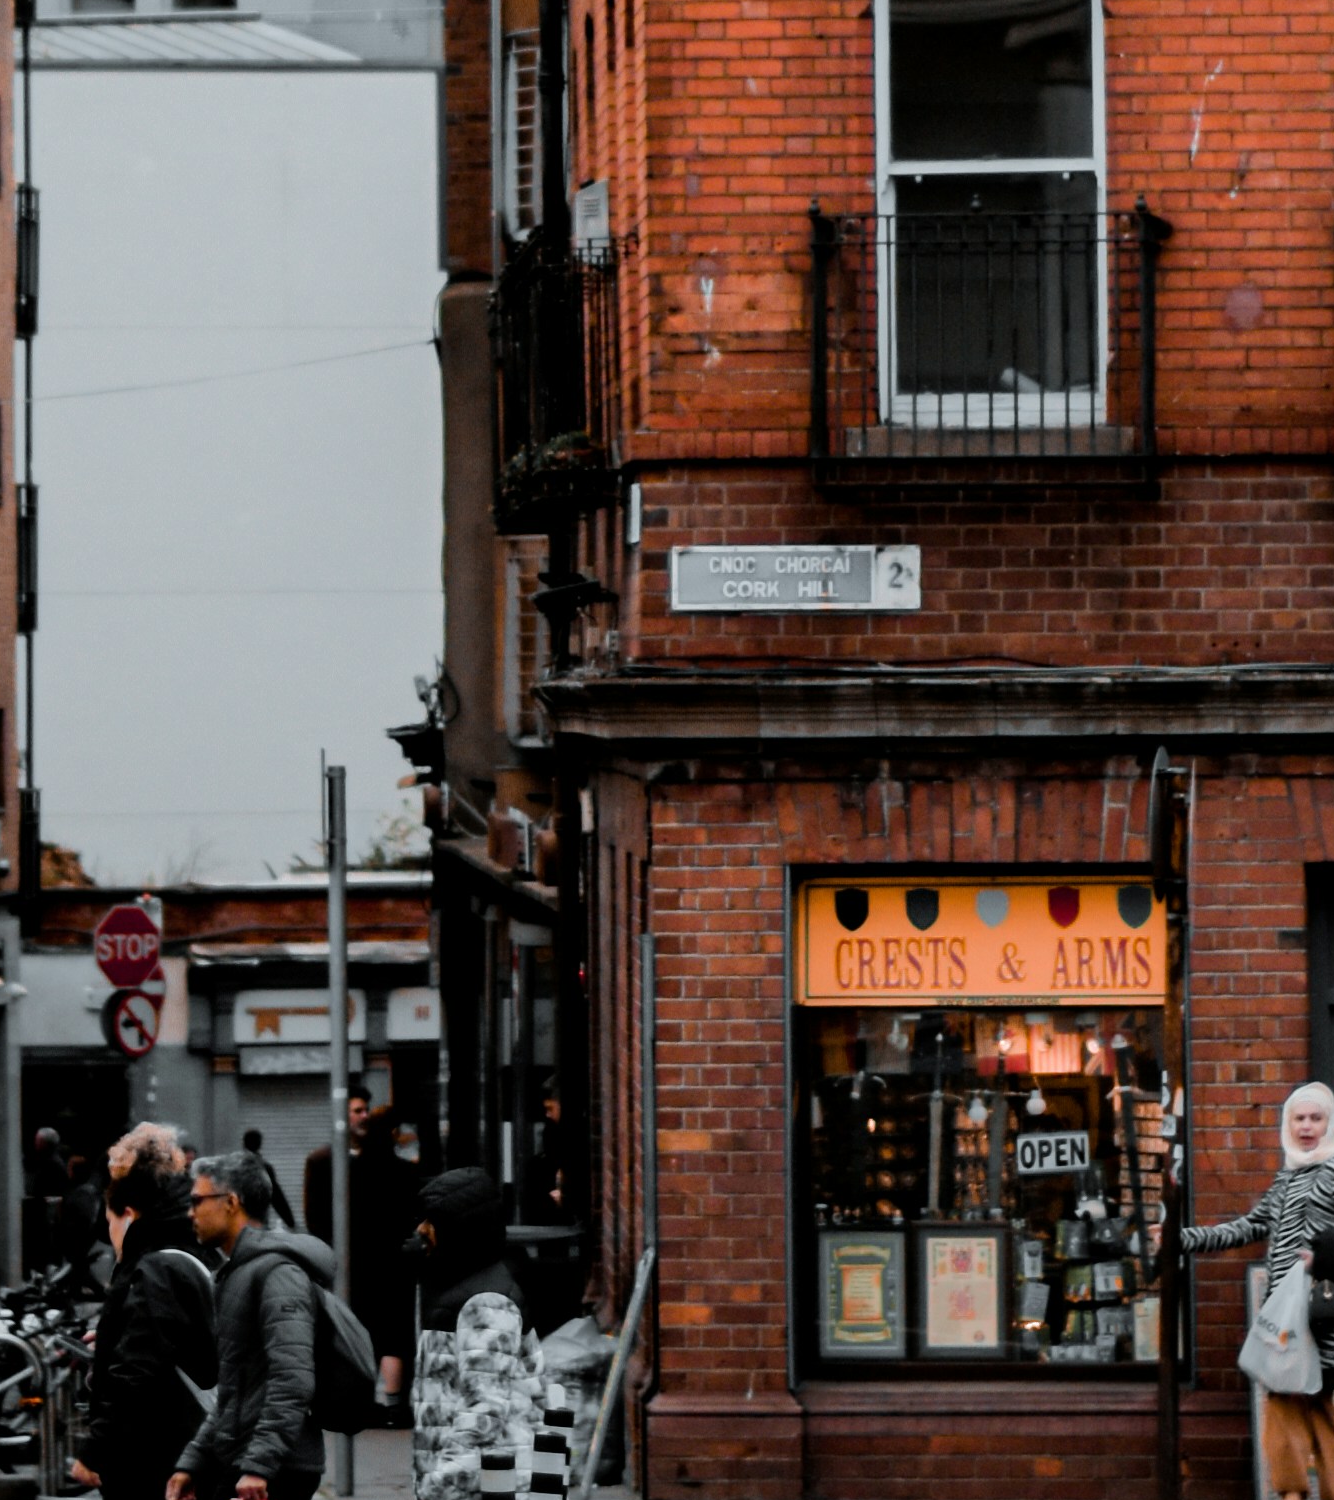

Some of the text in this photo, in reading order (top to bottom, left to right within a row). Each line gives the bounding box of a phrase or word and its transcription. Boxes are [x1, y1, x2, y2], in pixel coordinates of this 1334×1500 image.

[709, 552, 850, 574] CNOC CHORCAÍ
[722, 580, 839, 598] CORK HILL
[96, 933, 158, 961] STOP
[834, 936, 1154, 990] CRESTS & ARMS
[1020, 1138, 1086, 1169] OPEN
